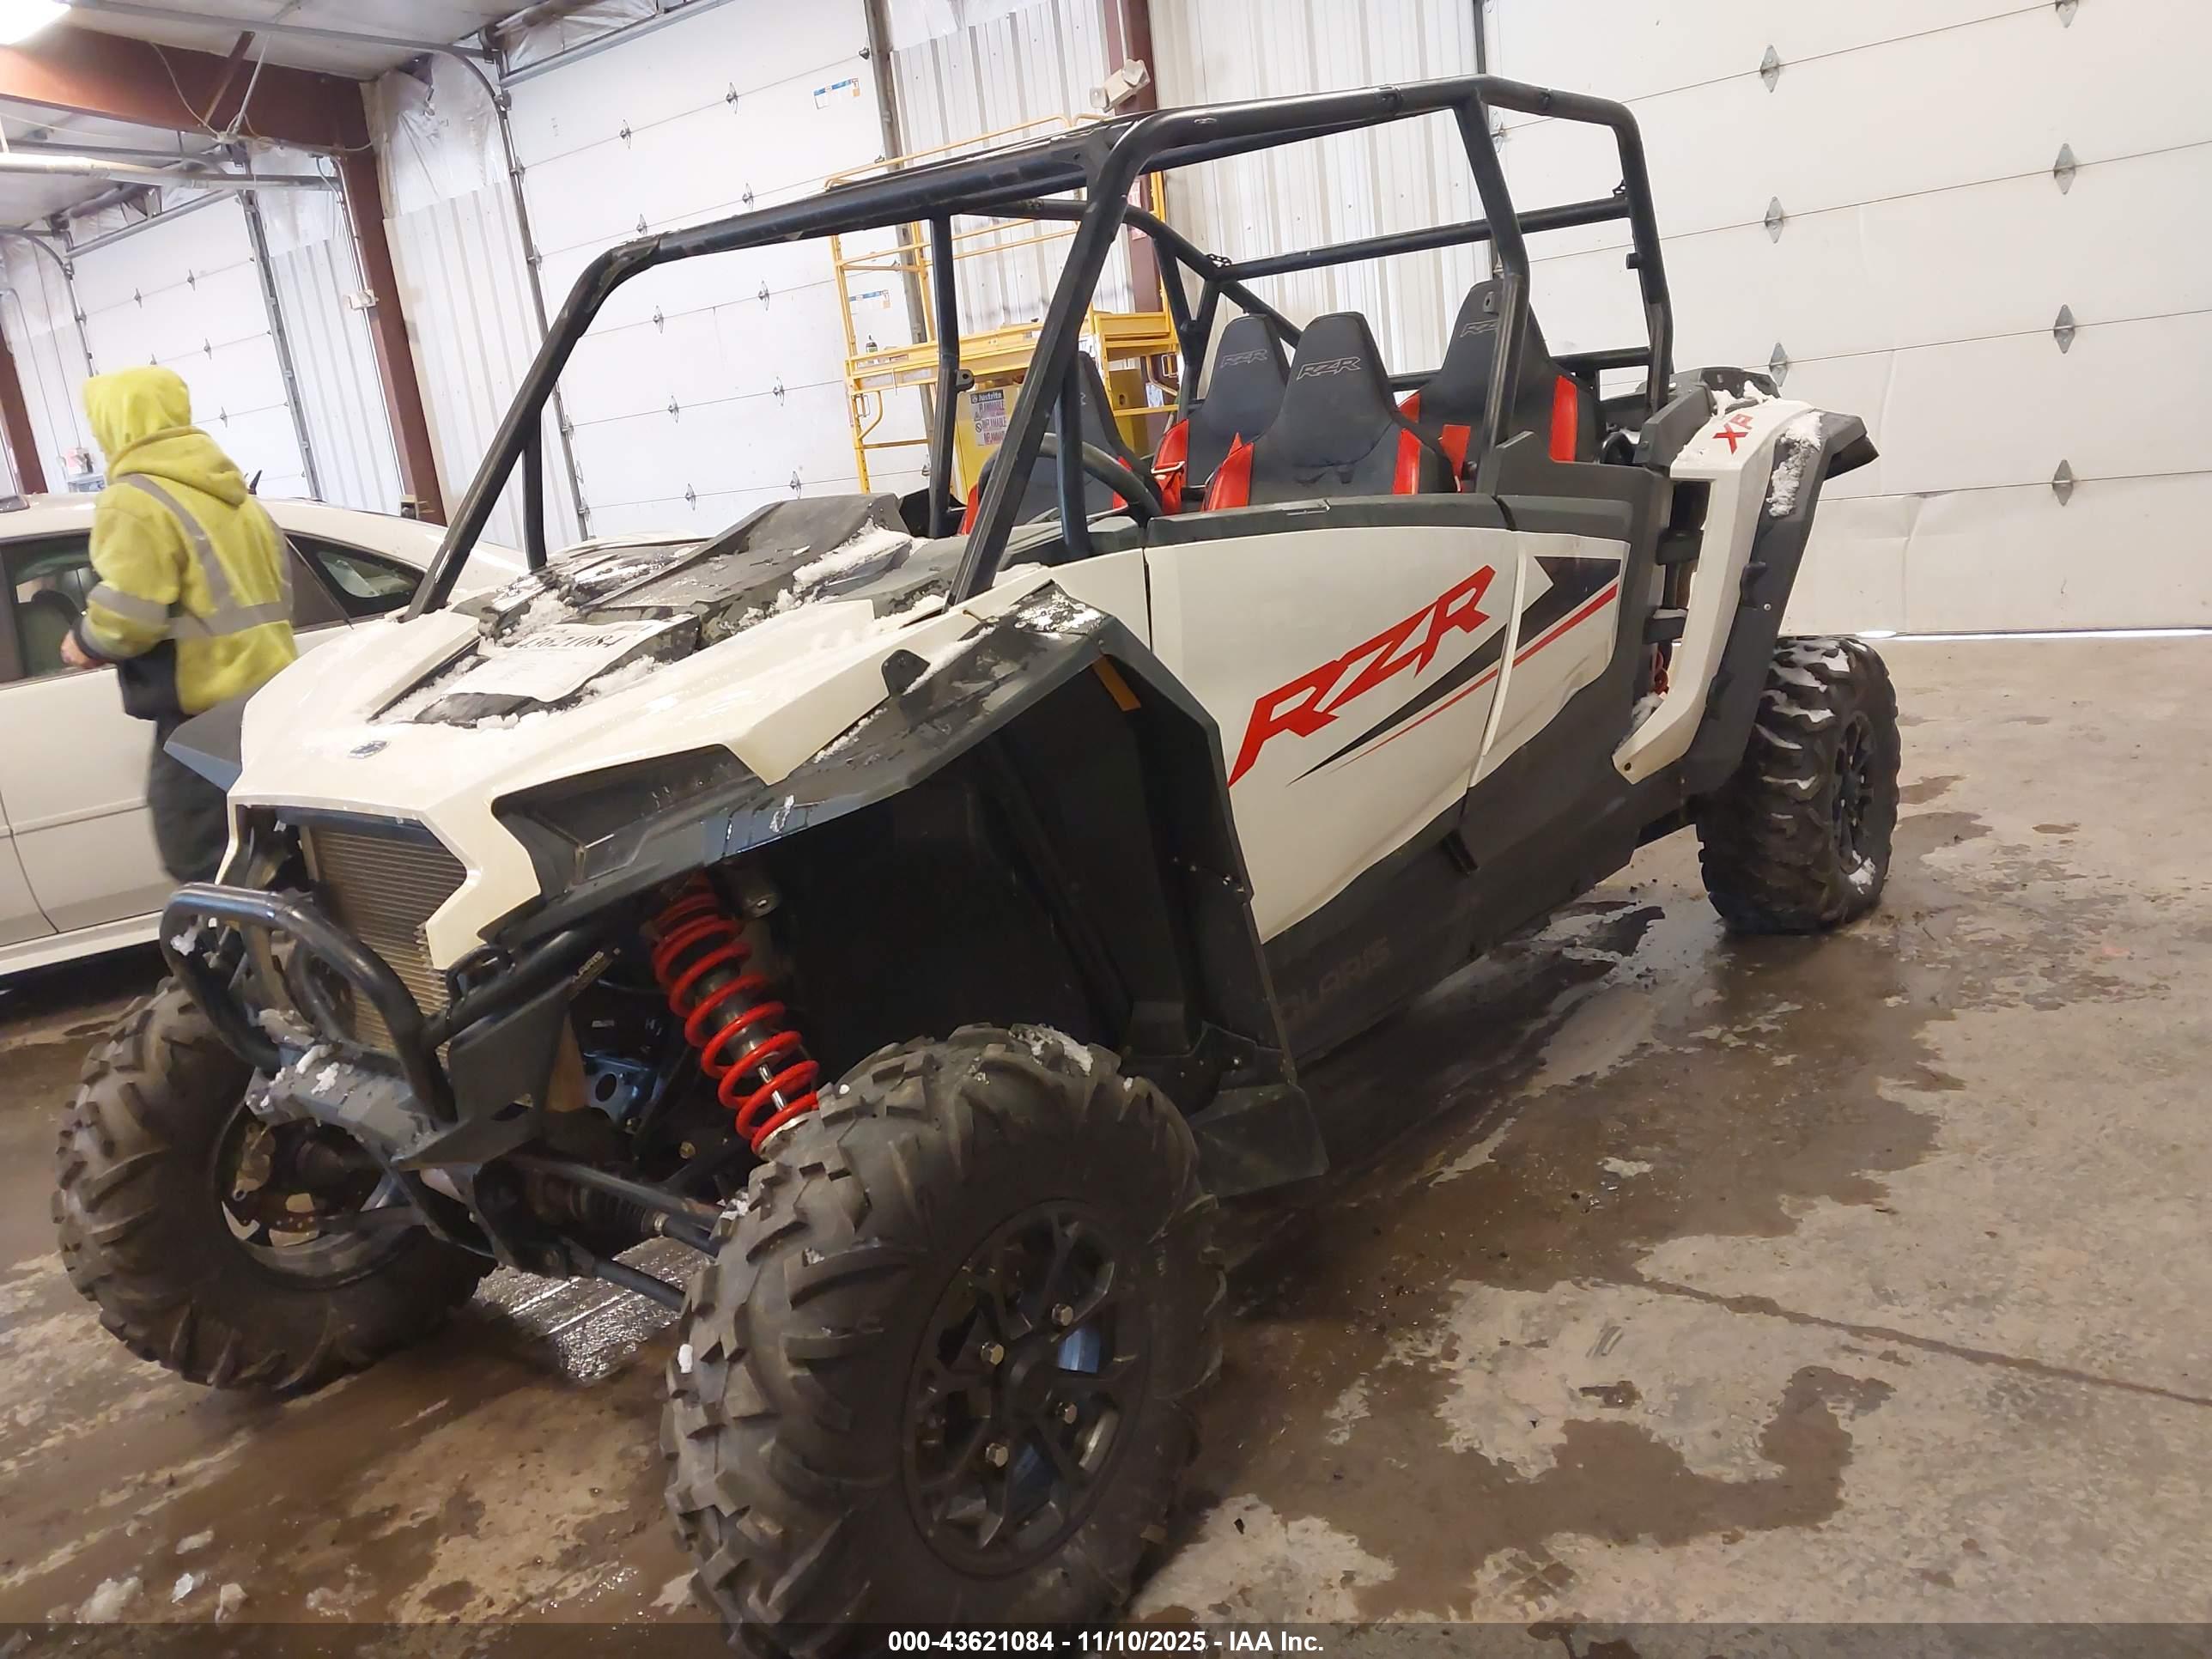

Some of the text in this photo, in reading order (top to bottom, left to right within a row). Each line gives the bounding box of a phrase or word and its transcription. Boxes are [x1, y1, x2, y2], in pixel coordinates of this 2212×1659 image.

[1460, 319, 1498, 337] RZ
[1219, 349, 1268, 369] RZR
[1297, 356, 1361, 381] RZR
[1711, 413, 1754, 455] XP
[1228, 564, 1497, 789] RZR
